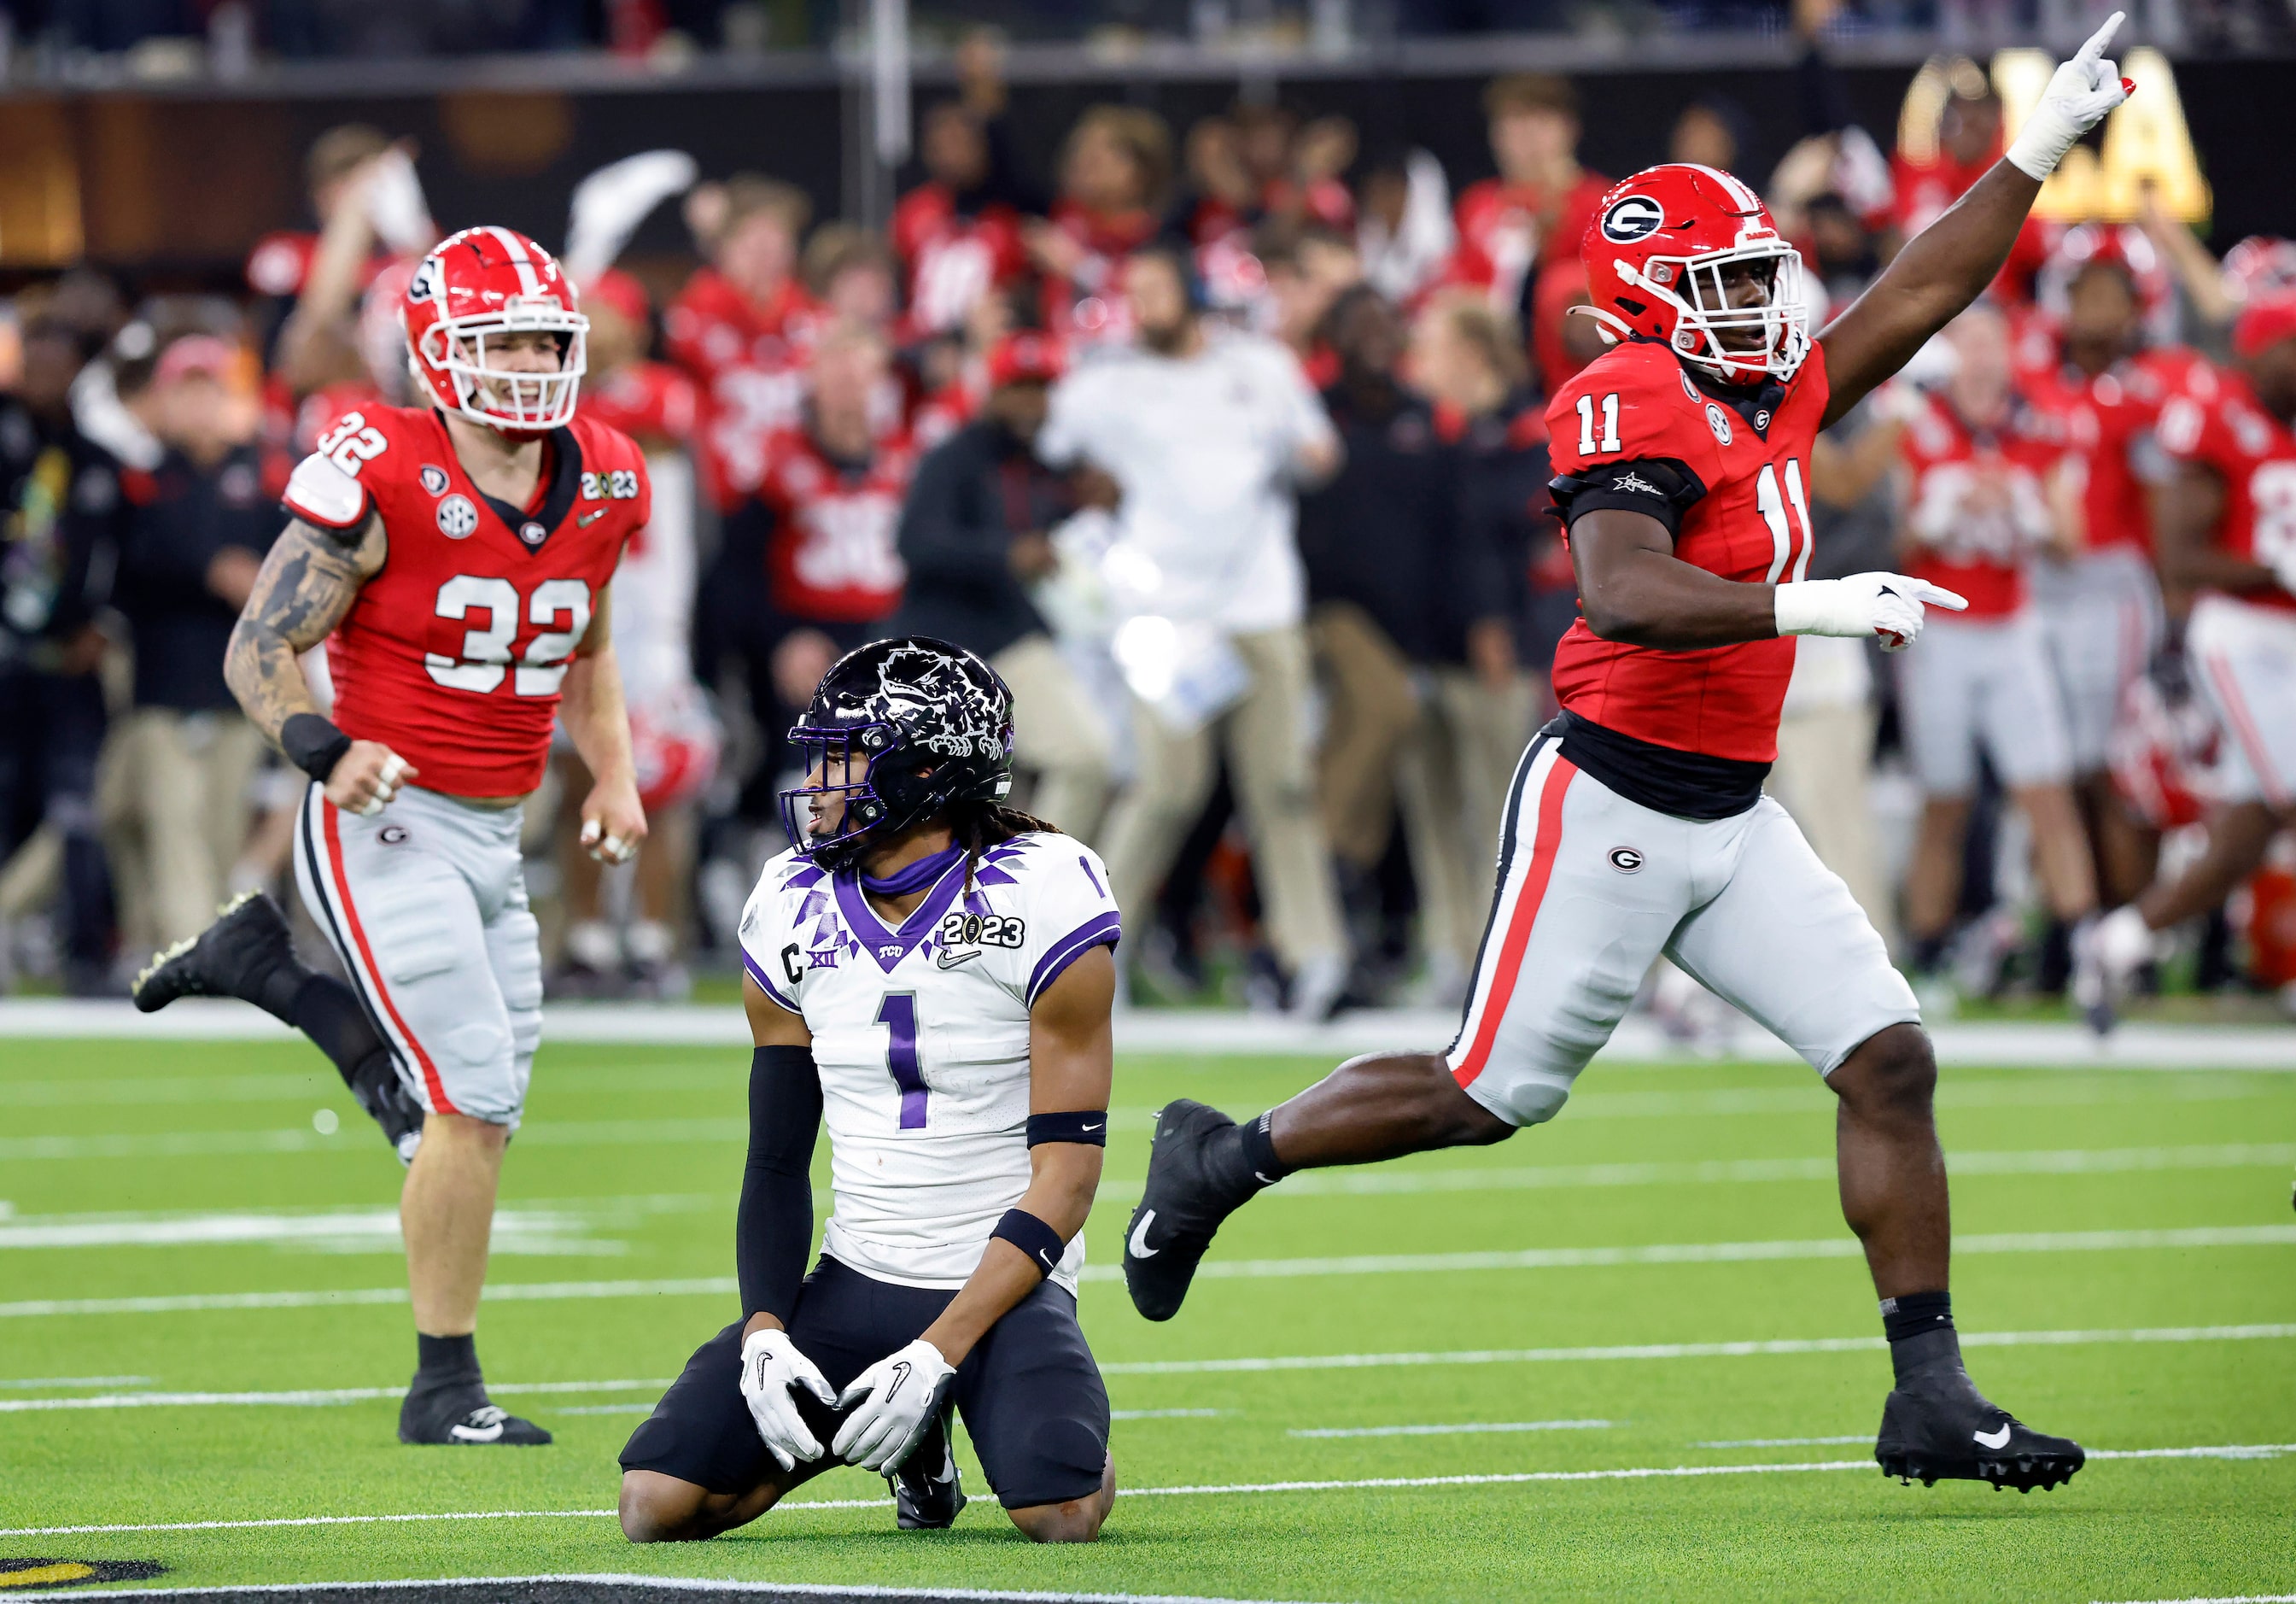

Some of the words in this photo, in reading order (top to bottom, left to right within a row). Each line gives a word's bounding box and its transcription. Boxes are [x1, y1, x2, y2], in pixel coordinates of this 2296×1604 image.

[1604, 196, 1662, 241] G
[317, 411, 389, 478] 32
[1575, 392, 1621, 455] 11
[581, 469, 639, 501] 2023
[1755, 457, 1814, 586] 11
[424, 573, 591, 697] 32
[1078, 855, 1107, 901] 1
[1610, 849, 1642, 870] G
[879, 945, 905, 960] TCU
[942, 914, 1025, 949] 2023
[780, 942, 803, 985] C
[805, 949, 839, 971] XII
[874, 992, 931, 1132] 1
